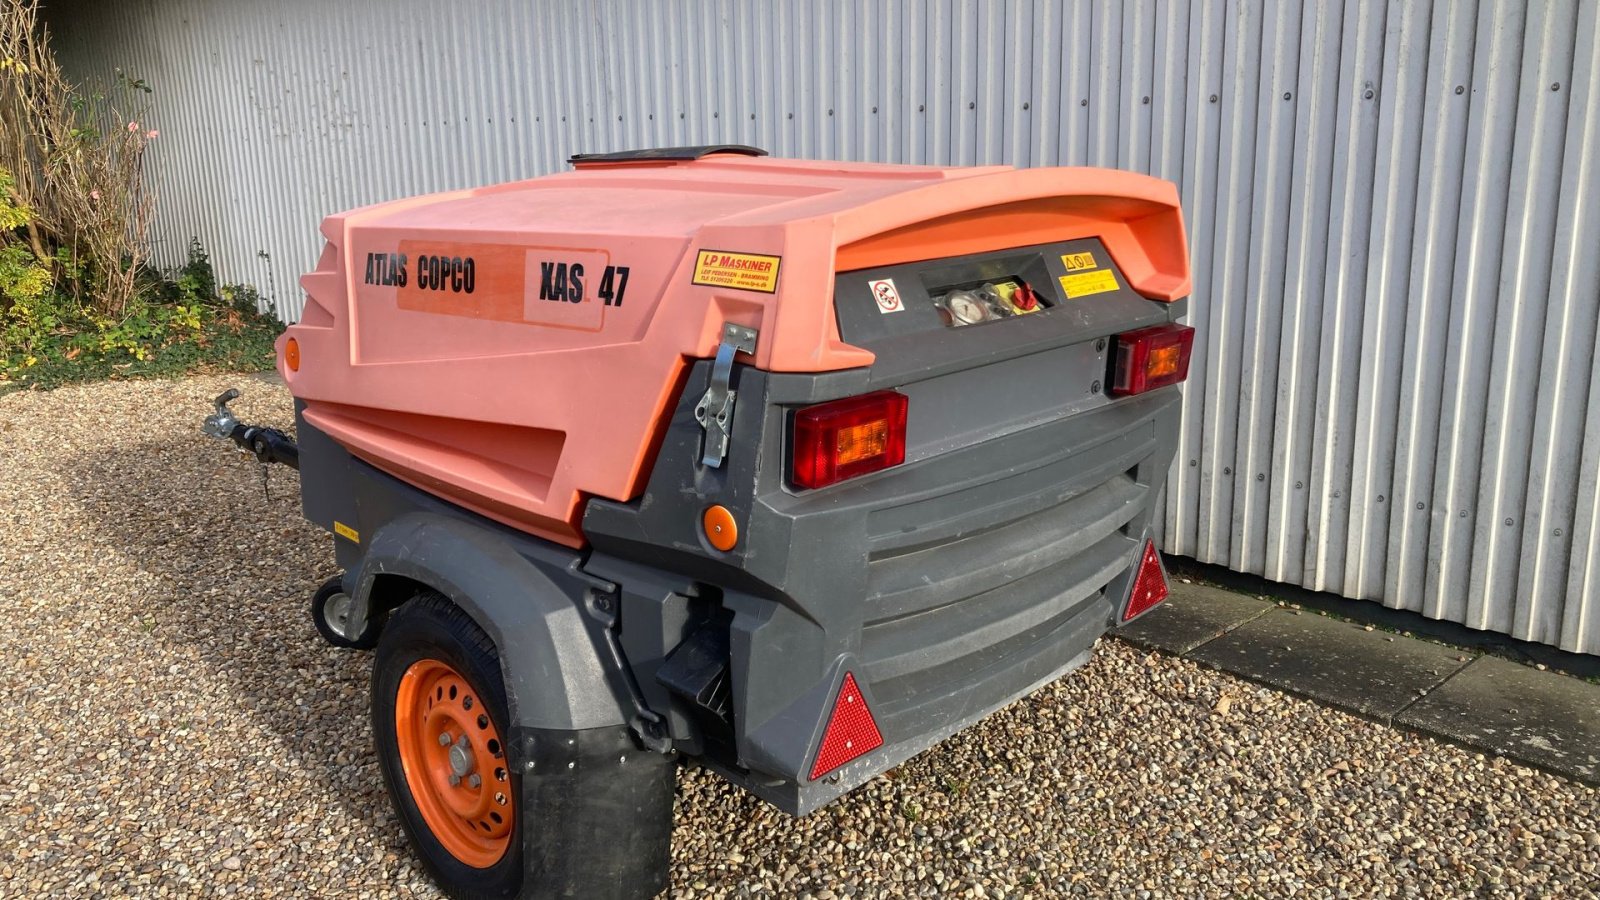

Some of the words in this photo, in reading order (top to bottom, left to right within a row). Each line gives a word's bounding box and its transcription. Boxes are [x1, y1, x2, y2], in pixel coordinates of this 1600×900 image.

[703, 254, 718, 266] LP
[719, 255, 772, 272] MASKINER
[365, 252, 408, 288] ATLAS
[417, 254, 476, 294] COPCO
[539, 261, 584, 304] XAS
[597, 265, 630, 307] 47
[712, 269, 738, 278] PEDERSEN
[741, 273, 770, 281] BRAMMING
